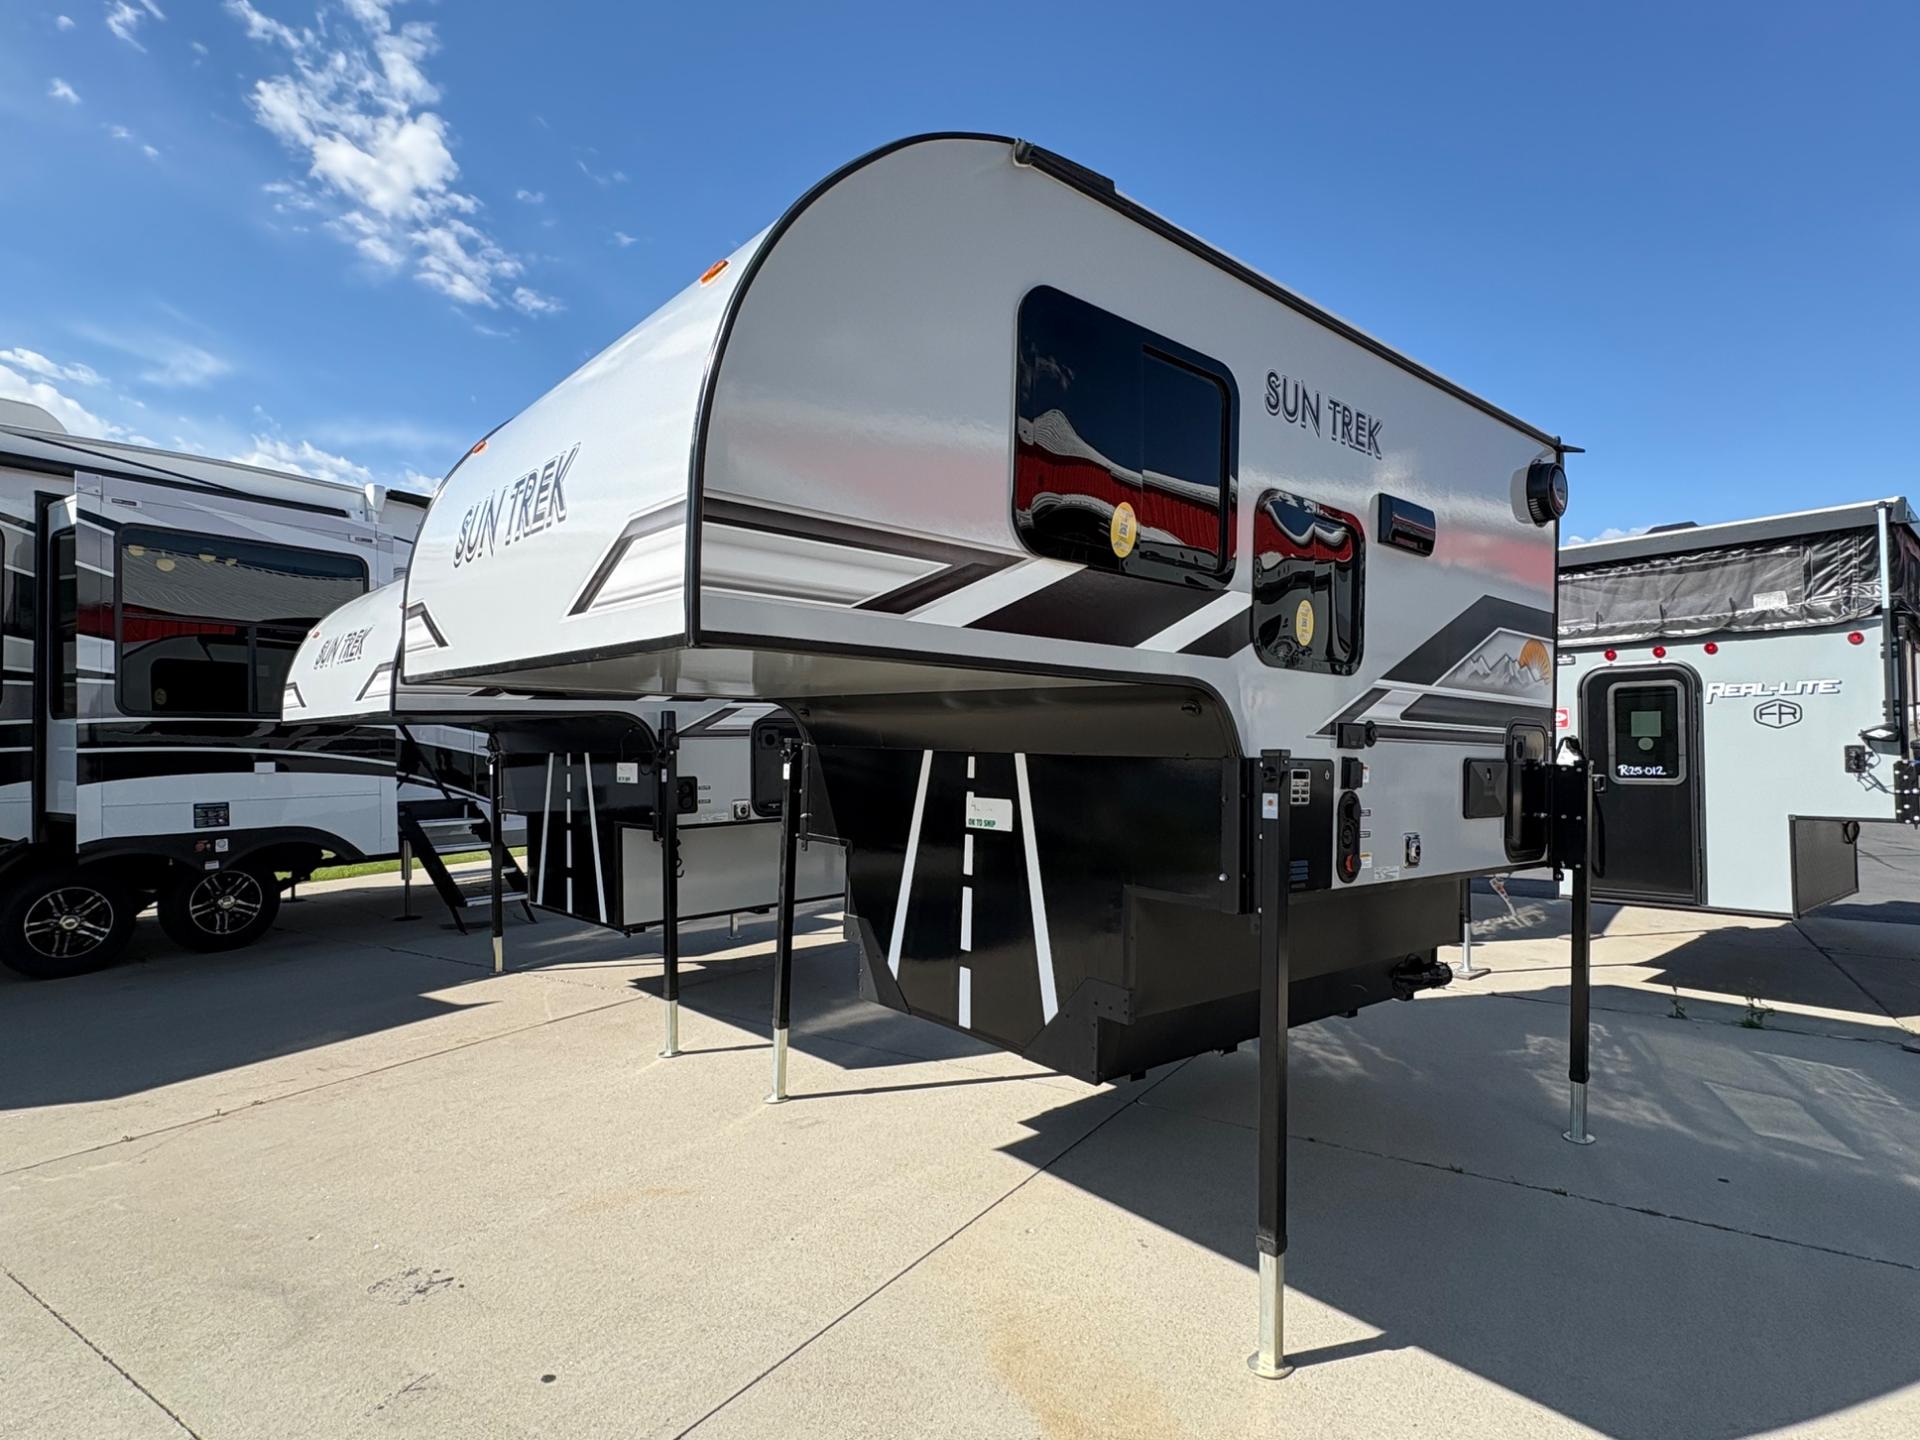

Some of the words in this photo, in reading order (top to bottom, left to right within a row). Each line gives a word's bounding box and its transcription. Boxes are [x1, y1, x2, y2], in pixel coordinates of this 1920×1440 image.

[1265, 369, 1320, 439] SUN
[1327, 396, 1382, 461] TREK
[454, 486, 508, 568] SUN
[504, 442, 581, 546] TREK
[313, 633, 345, 670] SUN
[337, 624, 375, 664] TREK
[1706, 679, 1842, 704] REAL-LITE
